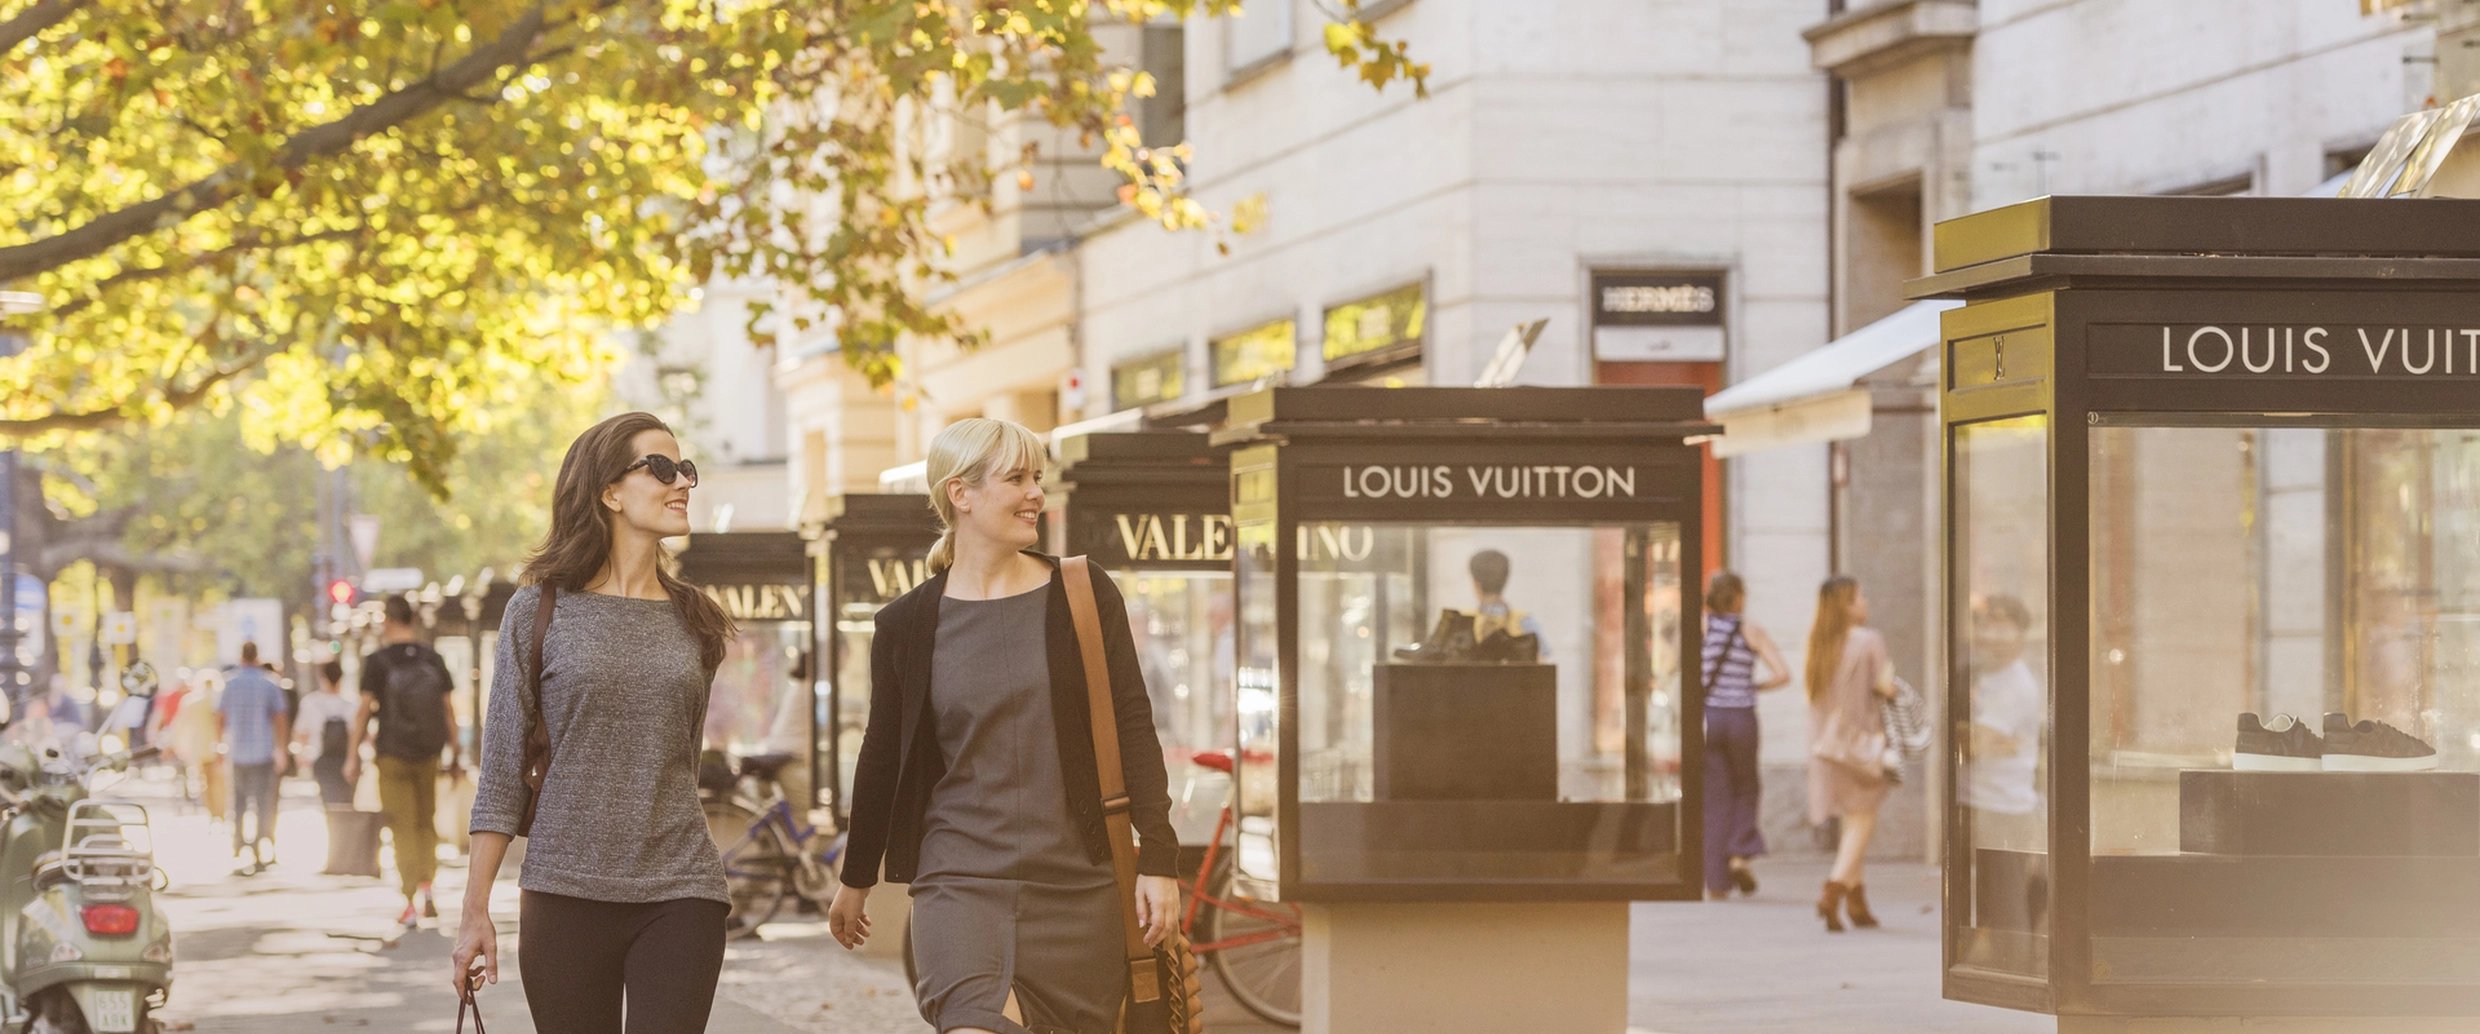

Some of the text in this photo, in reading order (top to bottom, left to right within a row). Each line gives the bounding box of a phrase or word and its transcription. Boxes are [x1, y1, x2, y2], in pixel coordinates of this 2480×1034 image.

[2163, 326, 2480, 375] LOUIS VUIT
[1344, 465, 1635, 498] LOUIS VUITTON
